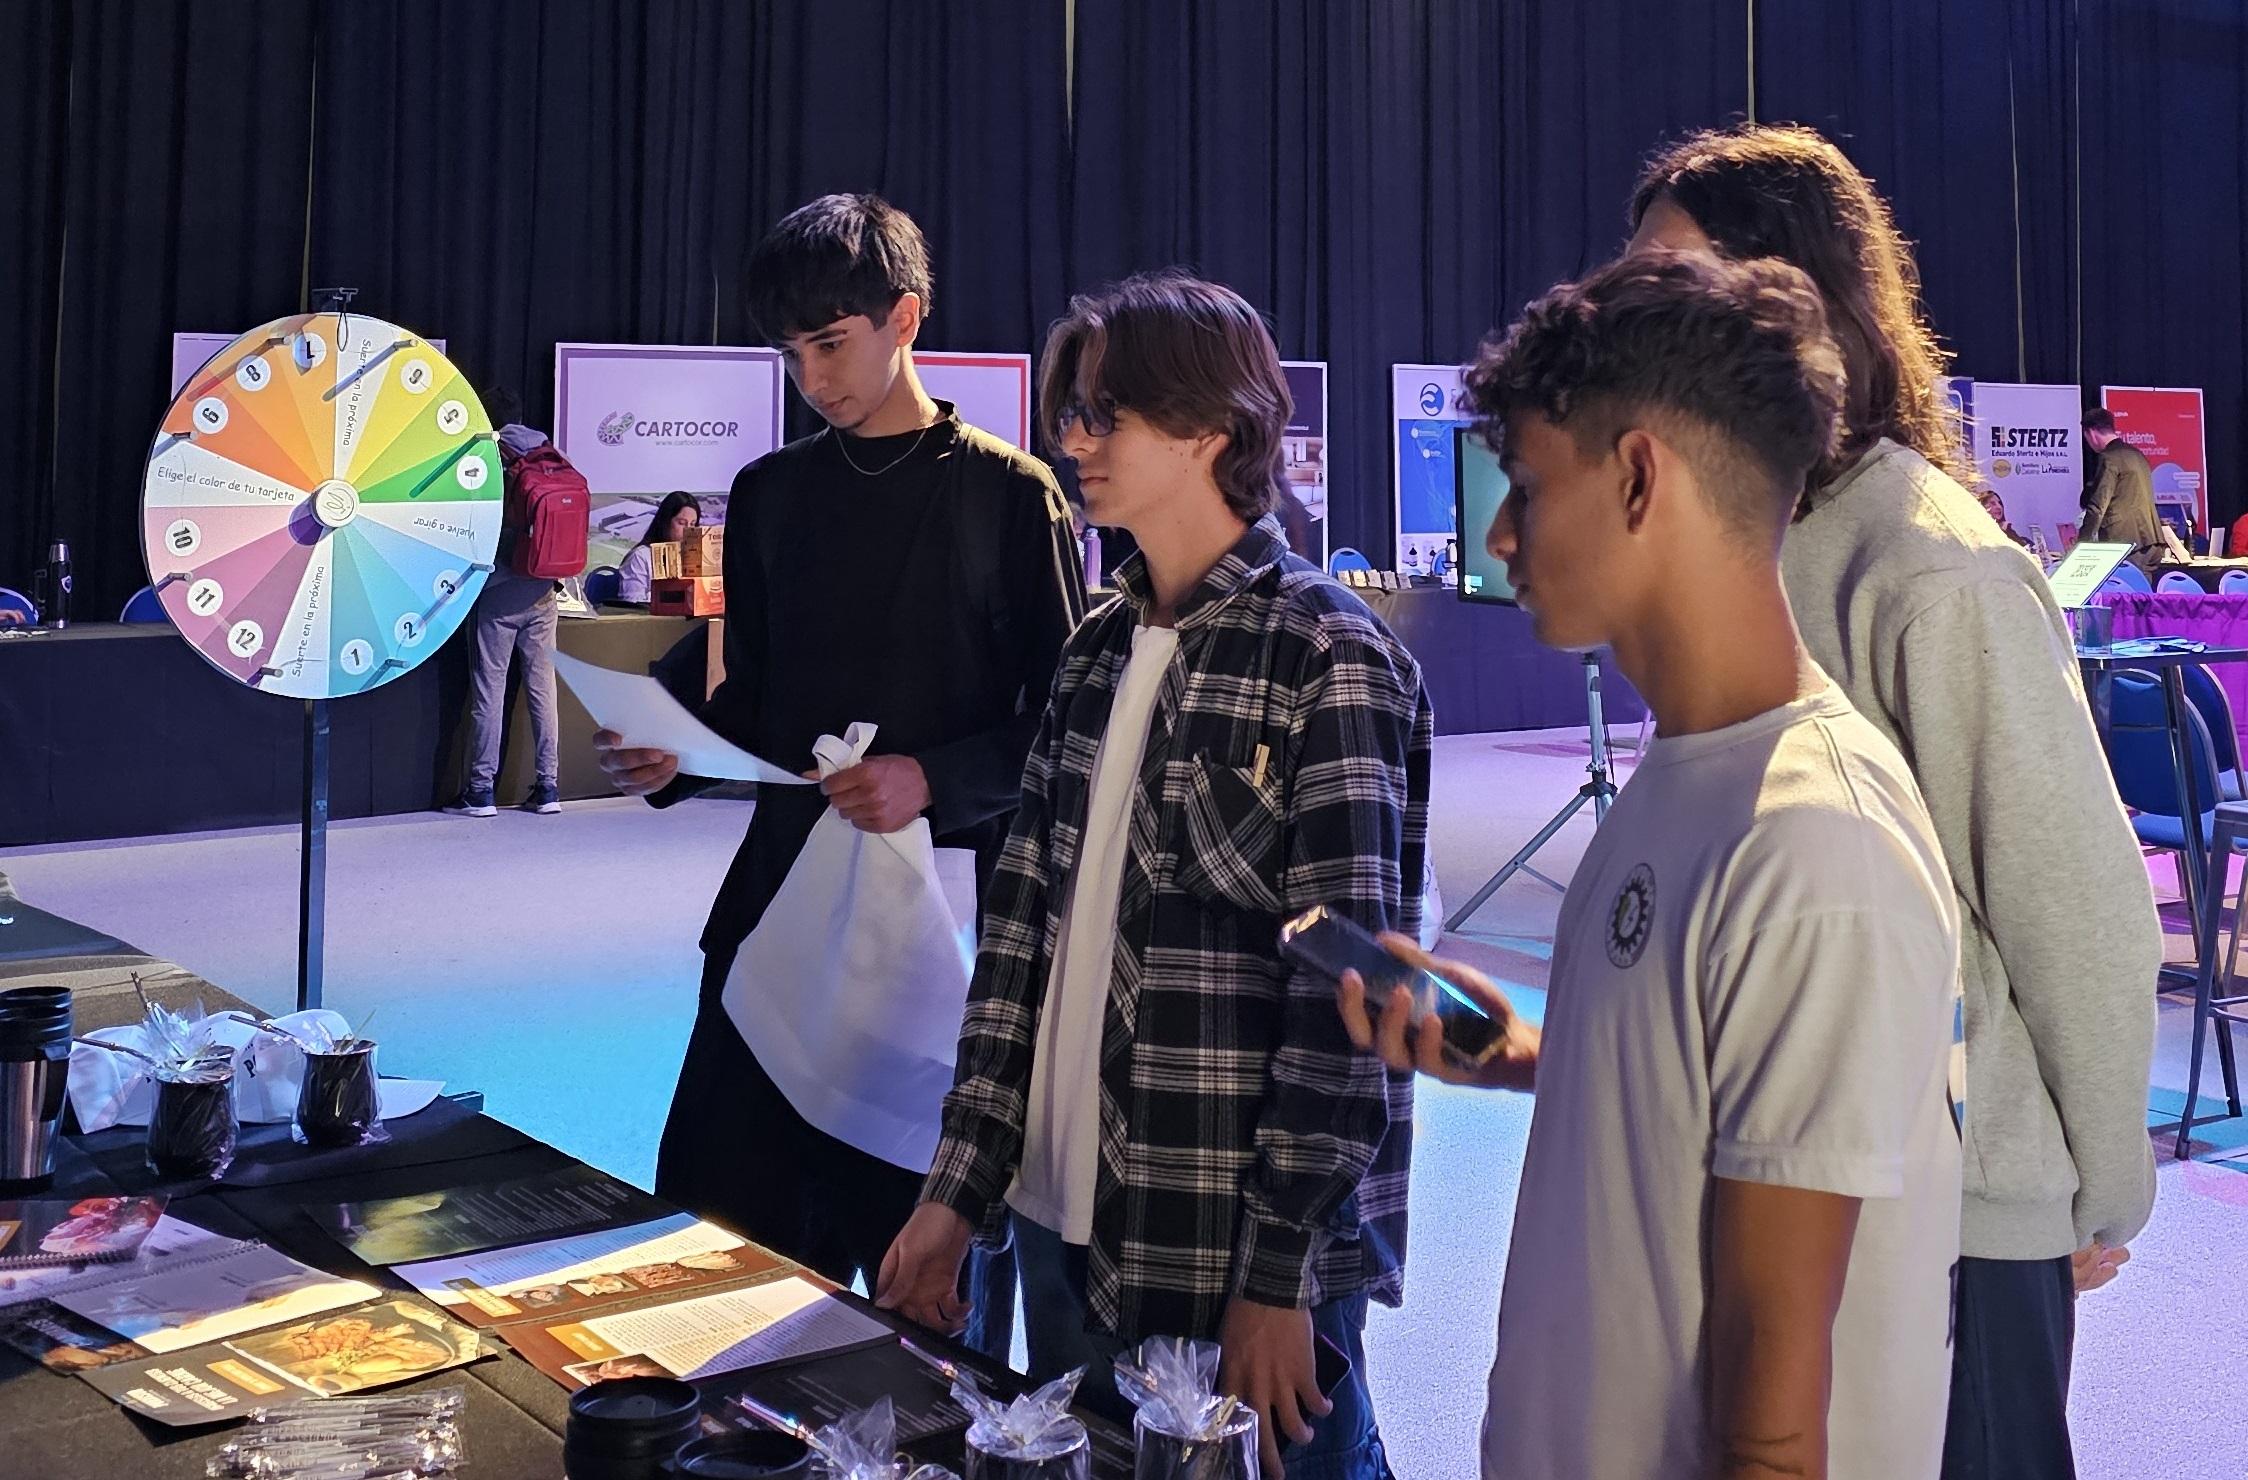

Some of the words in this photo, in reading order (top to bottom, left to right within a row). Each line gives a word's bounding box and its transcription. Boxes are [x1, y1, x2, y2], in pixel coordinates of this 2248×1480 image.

[245, 364, 261, 382] 8
[343, 403, 359, 446] próxima
[443, 408, 459, 425] 5
[635, 421, 739, 437] CARTOCOR
[2007, 428, 2069, 447] STERTZ
[1991, 449, 2016, 457] Eduardo
[2016, 449, 2034, 457] Stertz
[464, 467, 480, 478] 4
[157, 466, 184, 483] Elige
[186, 472, 197, 484] el
[199, 476, 226, 488] color
[228, 480, 241, 491] de
[244, 484, 255, 494] tu
[257, 487, 295, 501] tarjeta
[414, 518, 438, 529] girar
[172, 526, 194, 549] 10
[447, 525, 475, 541] Vuelve
[309, 566, 325, 609] próxima
[440, 579, 456, 595] 3
[194, 586, 216, 609] 11
[303, 611, 315, 621] la
[302, 622, 312, 637] en
[403, 621, 417, 640] 2
[235, 628, 256, 651] 12
[291, 639, 308, 677] Suerte
[350, 648, 360, 667] 1
